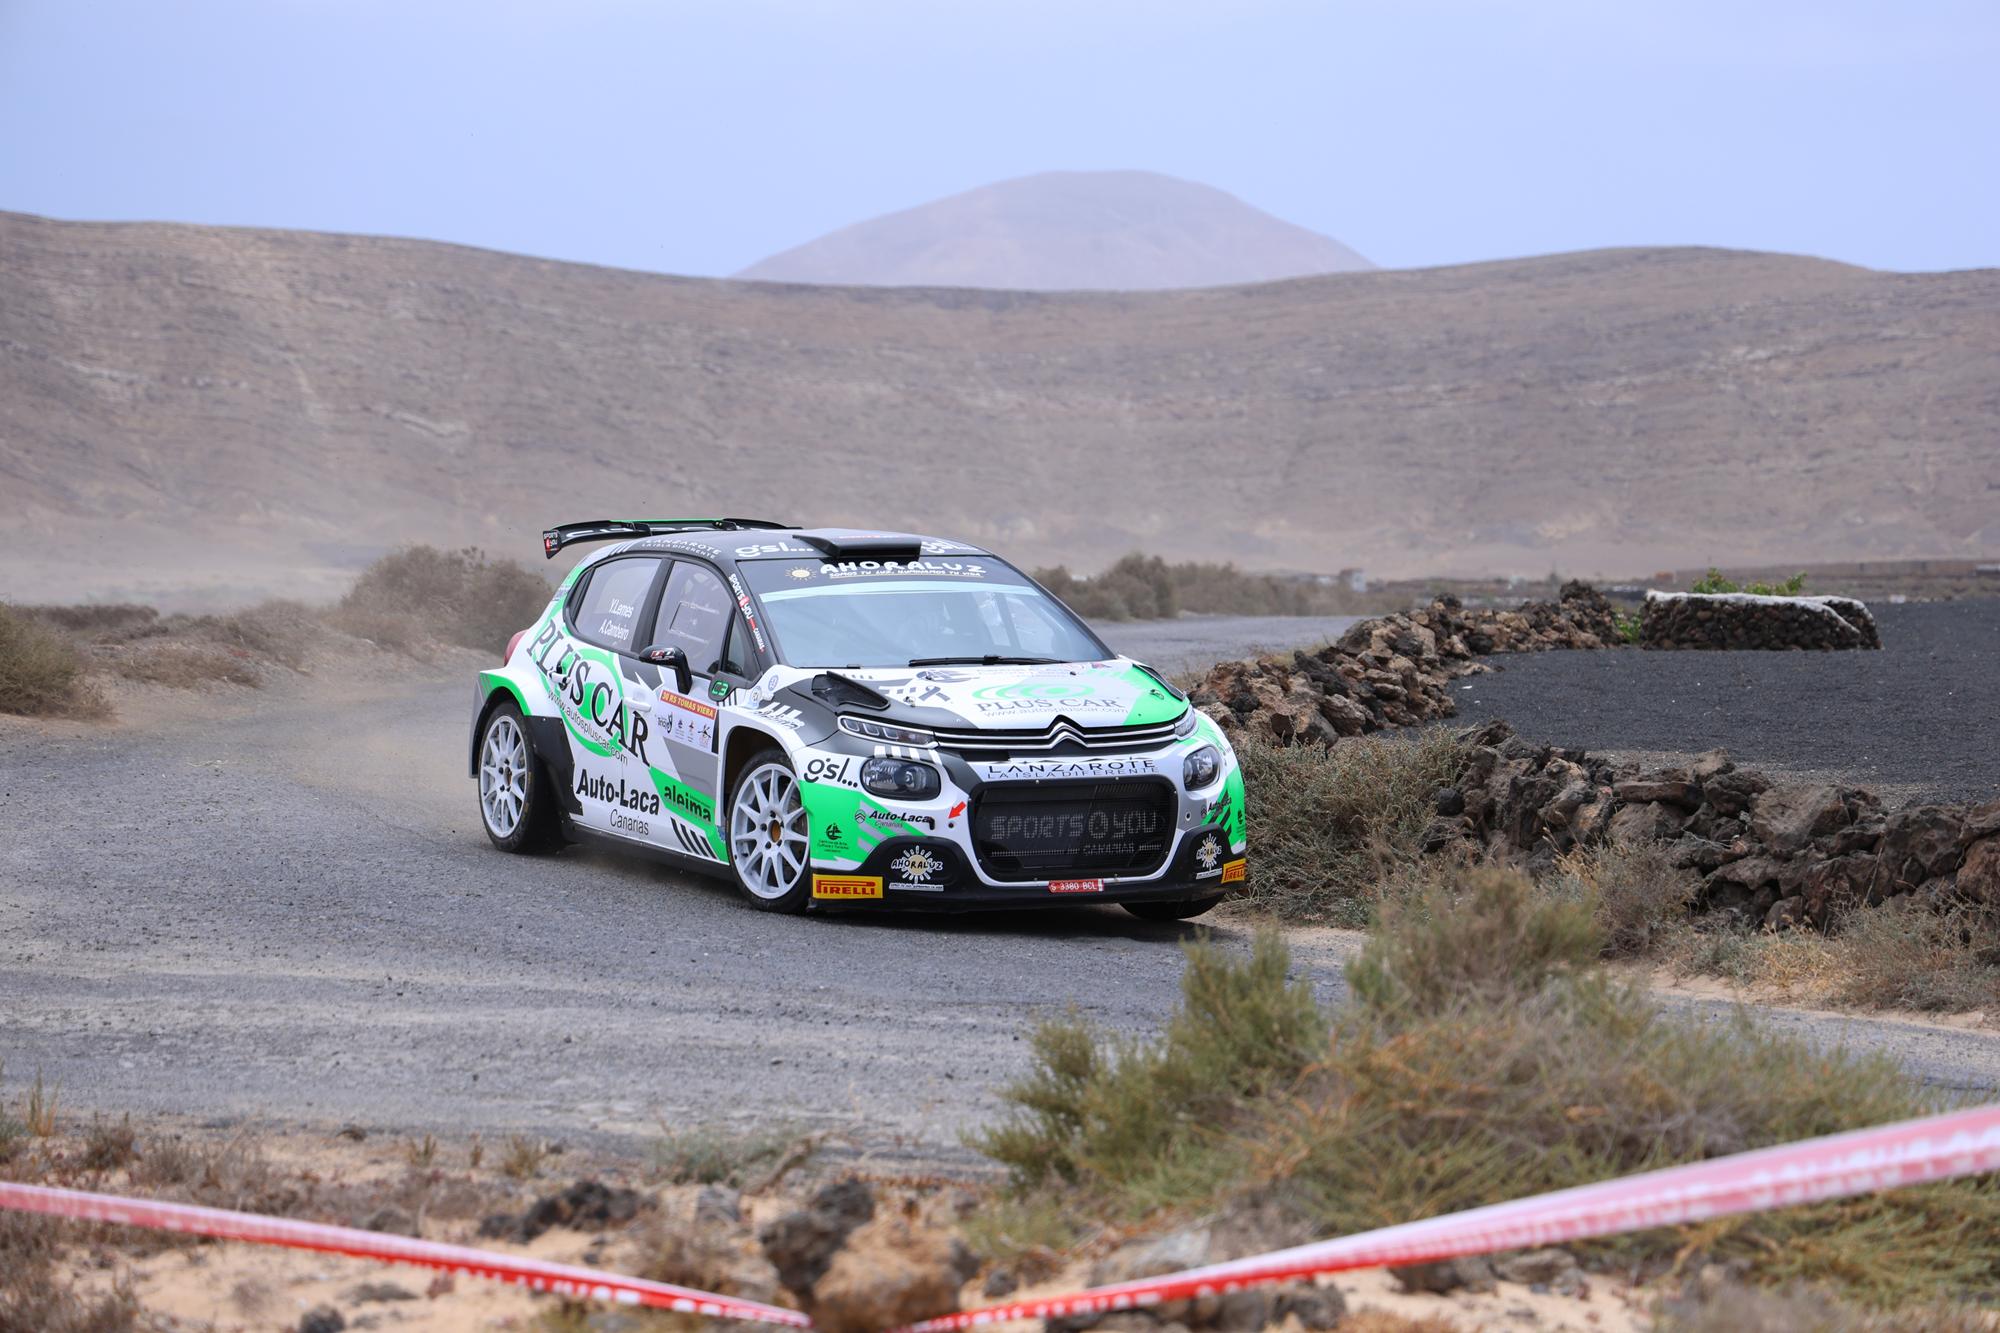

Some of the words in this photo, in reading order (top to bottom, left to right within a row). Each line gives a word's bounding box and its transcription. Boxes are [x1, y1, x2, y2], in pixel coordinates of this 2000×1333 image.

[645, 539, 722, 555] LANZAROTE
[820, 560, 987, 574] AHORALUZ
[526, 619, 592, 706] PLUS
[591, 682, 651, 767] CAR
[976, 699, 1053, 712] PLUS
[1059, 698, 1126, 708] CAR
[988, 759, 1156, 776] LANZAROTE
[1061, 767, 1161, 777] DIFERENTE
[575, 769, 660, 816] Auto-Laca
[609, 808, 649, 836] Canarias
[869, 810, 933, 823] Auto-Laca
[991, 812, 1084, 840] SPORTS
[1113, 810, 1157, 839] YOU
[891, 858, 944, 872] AHORALUZ
[815, 879, 876, 895] PIRELLI
